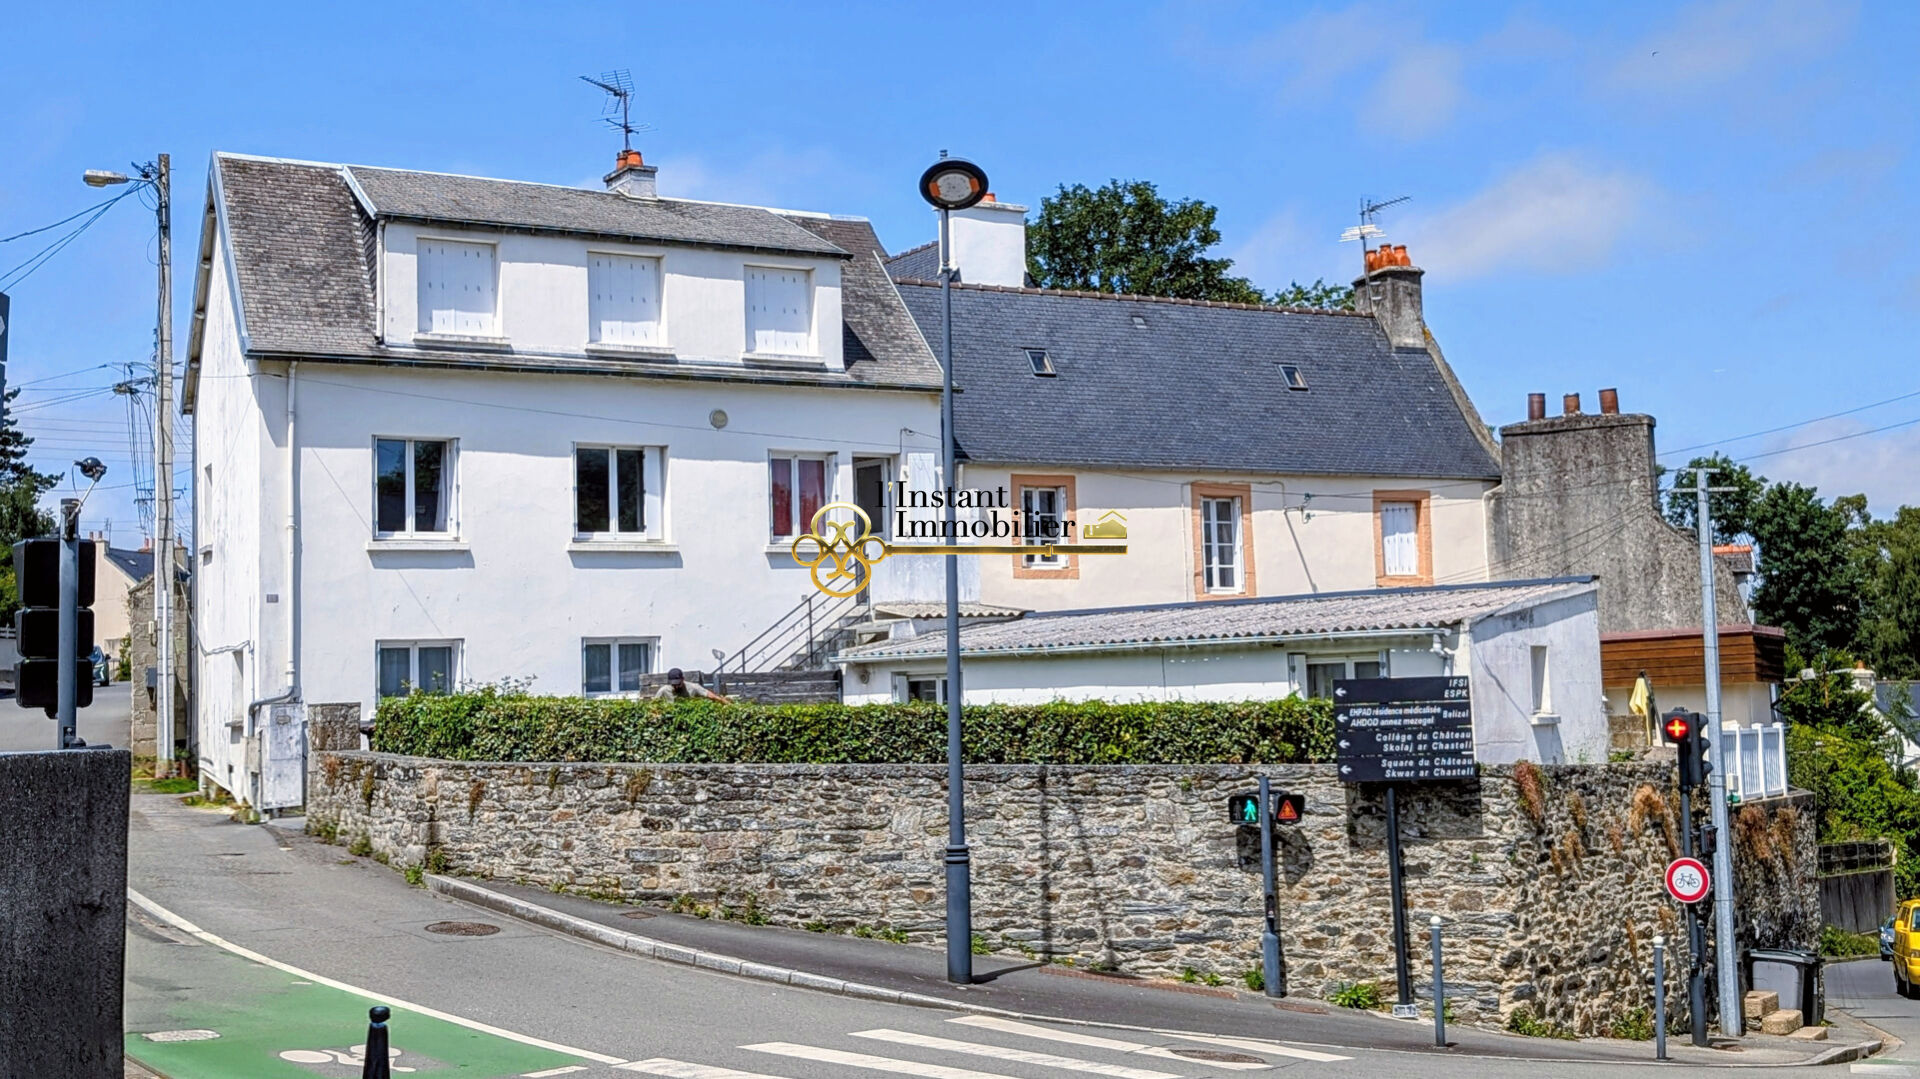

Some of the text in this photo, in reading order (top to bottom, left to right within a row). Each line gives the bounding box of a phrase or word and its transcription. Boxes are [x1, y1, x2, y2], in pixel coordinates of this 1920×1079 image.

[1449, 679, 1468, 688] IFSI
[1372, 706, 1402, 716] résidence
[1375, 731, 1471, 742] Collège du Château
[1383, 742, 1413, 753] Skolaj
[1417, 743, 1427, 751] ar
[1381, 757, 1473, 769] Square du Château
[1385, 769, 1415, 778] Skwar
[1418, 769, 1429, 777] ar
